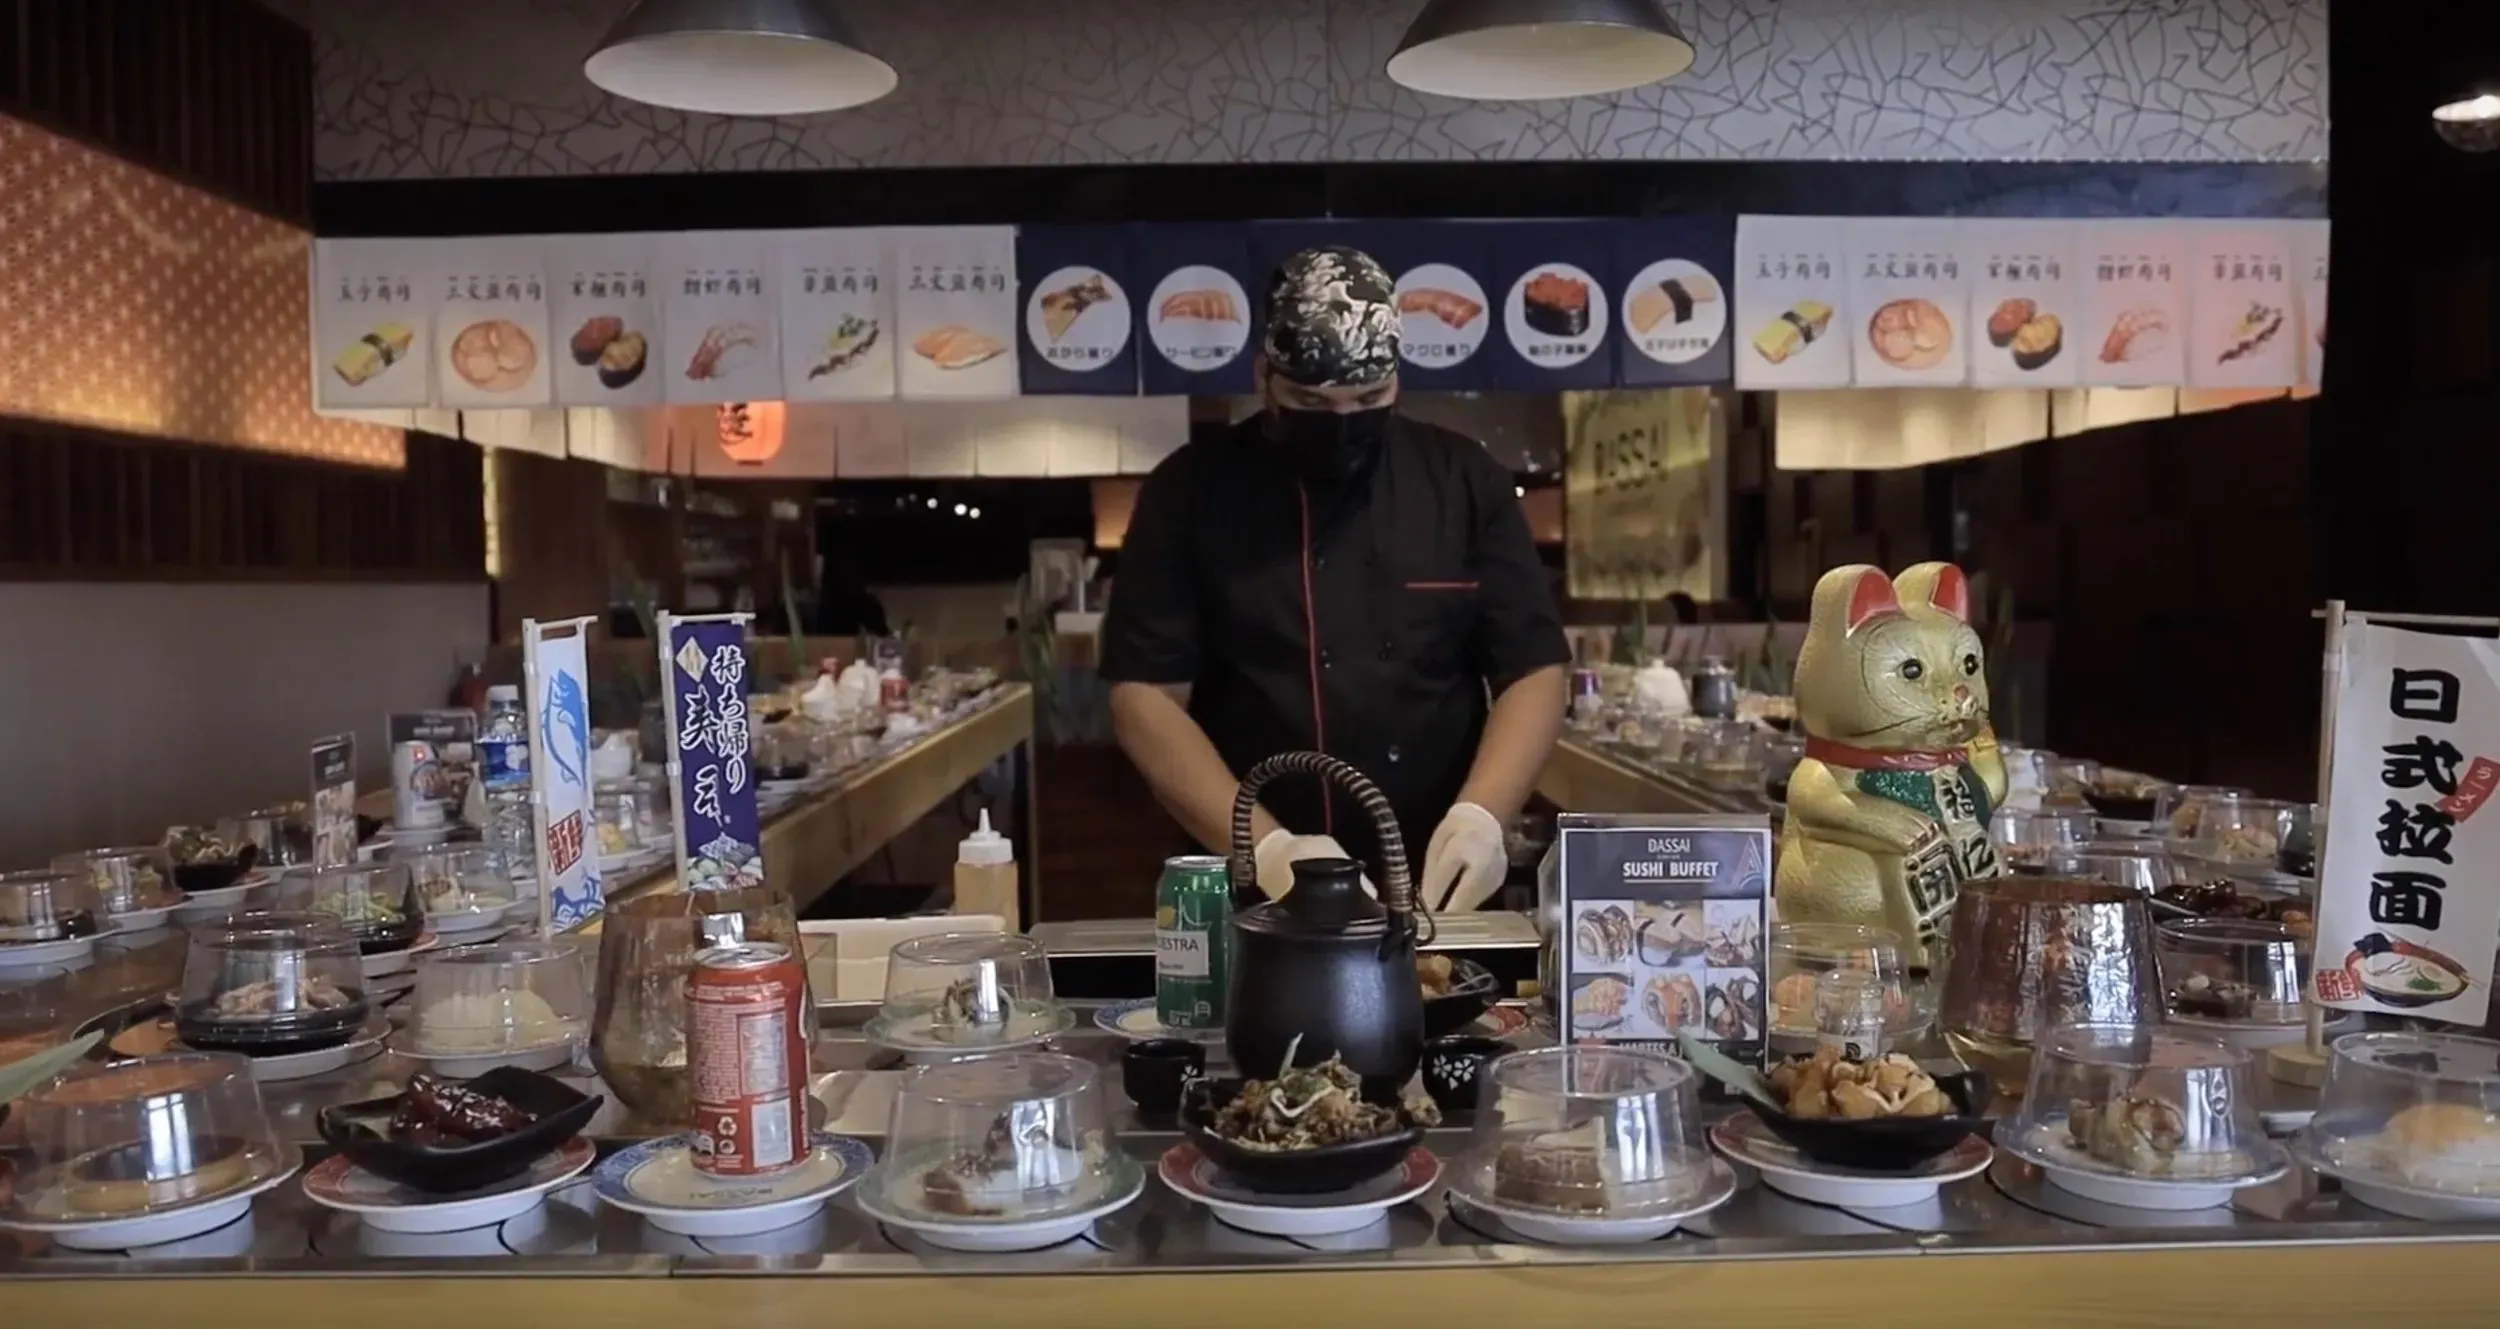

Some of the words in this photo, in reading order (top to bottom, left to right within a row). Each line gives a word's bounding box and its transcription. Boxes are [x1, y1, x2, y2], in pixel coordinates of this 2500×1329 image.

[711, 645, 748, 795] 持ち帰り
[2369, 668, 2464, 931] 日式拉面
[1623, 862, 1664, 877] SUSHI
[1669, 861, 1719, 877] BUFFET
[1648, 838, 1691, 854] DASSAI
